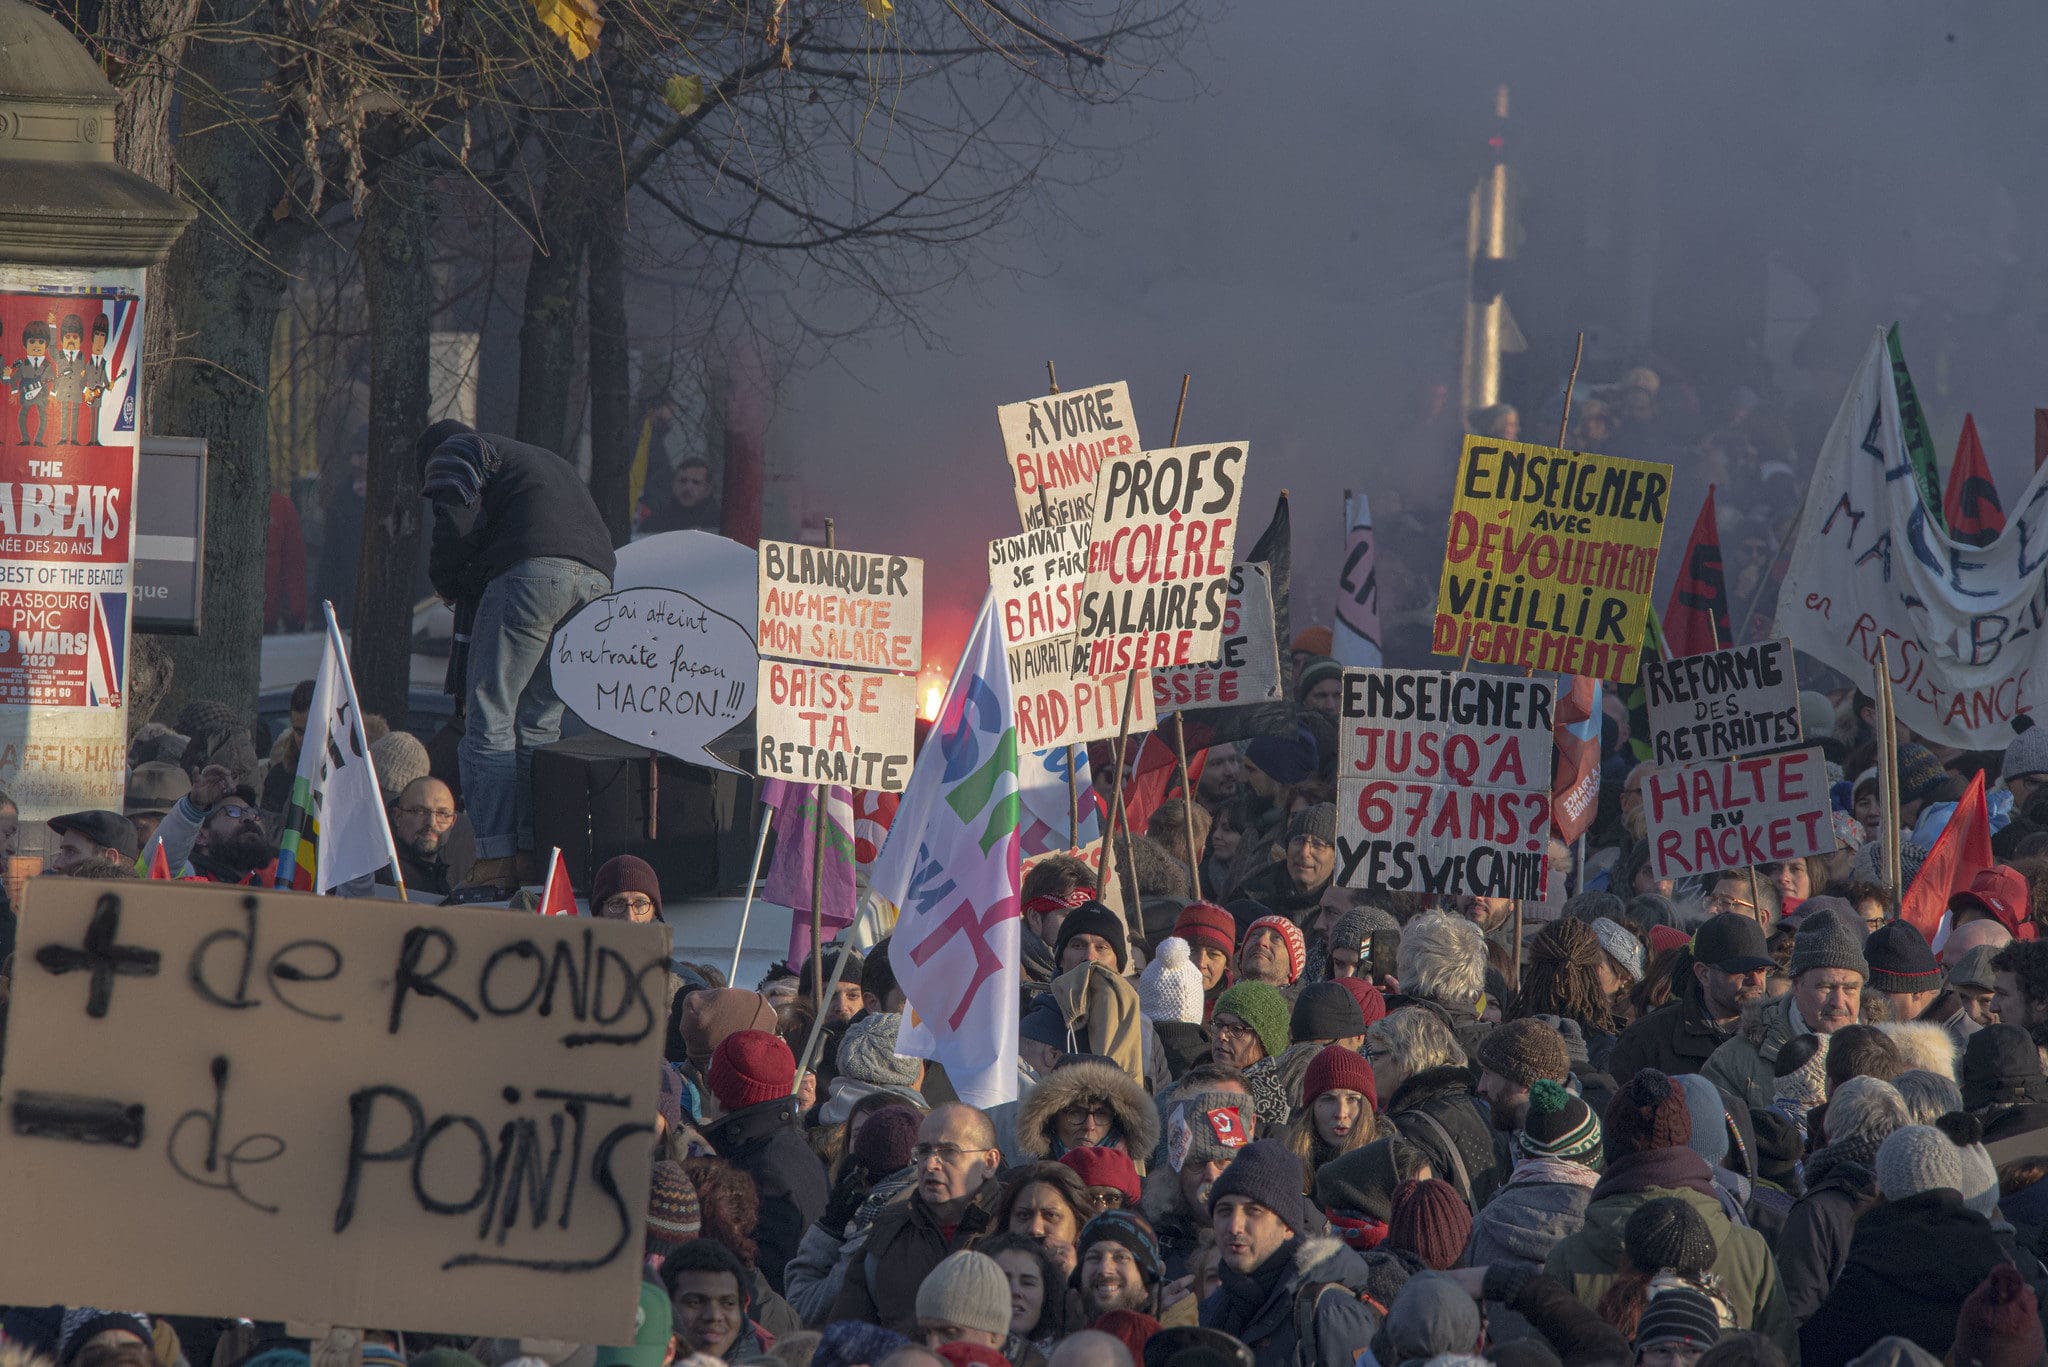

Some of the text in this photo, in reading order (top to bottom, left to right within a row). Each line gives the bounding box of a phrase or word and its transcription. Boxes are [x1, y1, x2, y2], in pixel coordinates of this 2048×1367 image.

[1043, 388, 1123, 441] VOTRE
[28, 460, 62, 477] THE
[1104, 446, 1242, 523] PROFS
[1464, 446, 1667, 524] ENSEIGNER
[26, 539, 50, 553] DES
[53, 541, 68, 554] 20
[71, 542, 92, 555] ANS
[1530, 510, 1591, 534] AVEC
[38, 568, 57, 584] OF
[61, 569, 84, 585] THE
[88, 569, 123, 585] BEATLES
[766, 543, 908, 597] BLANQUER
[1013, 565, 1034, 588] SE
[1447, 509, 1659, 595] DÉVOUEMENT
[13, 609, 61, 630] PMC
[595, 596, 707, 634] J'ai atteint
[765, 587, 891, 629] AUGMENTE
[1081, 577, 1229, 637] SALAIRES
[1449, 570, 1628, 643] VIEILLIR
[18, 631, 87, 655] MARS
[21, 655, 55, 667] 2020
[670, 644, 725, 683] façon
[759, 618, 912, 667] MON SALAIRE
[1073, 643, 1091, 674] DE
[1432, 611, 1635, 682] DIGNEMENT
[770, 663, 882, 713] BAISSE
[1343, 671, 1554, 731] ENSEIGNER
[1648, 642, 1782, 707] REFORME
[1074, 671, 1149, 734] PITT
[1695, 693, 1739, 721] DES
[799, 712, 852, 753] TA
[1656, 706, 1799, 766] RETRAITES
[761, 735, 907, 790] RETRAITE
[1650, 753, 1808, 823] HALTE
[1657, 810, 1823, 876] RACKET
[1711, 810, 1743, 829] AU
[1336, 836, 1415, 891] YES
[189, 896, 342, 1022] de
[388, 923, 671, 1048] RONDS
[167, 1056, 286, 1214] de
[335, 1084, 655, 1271] POINTS
